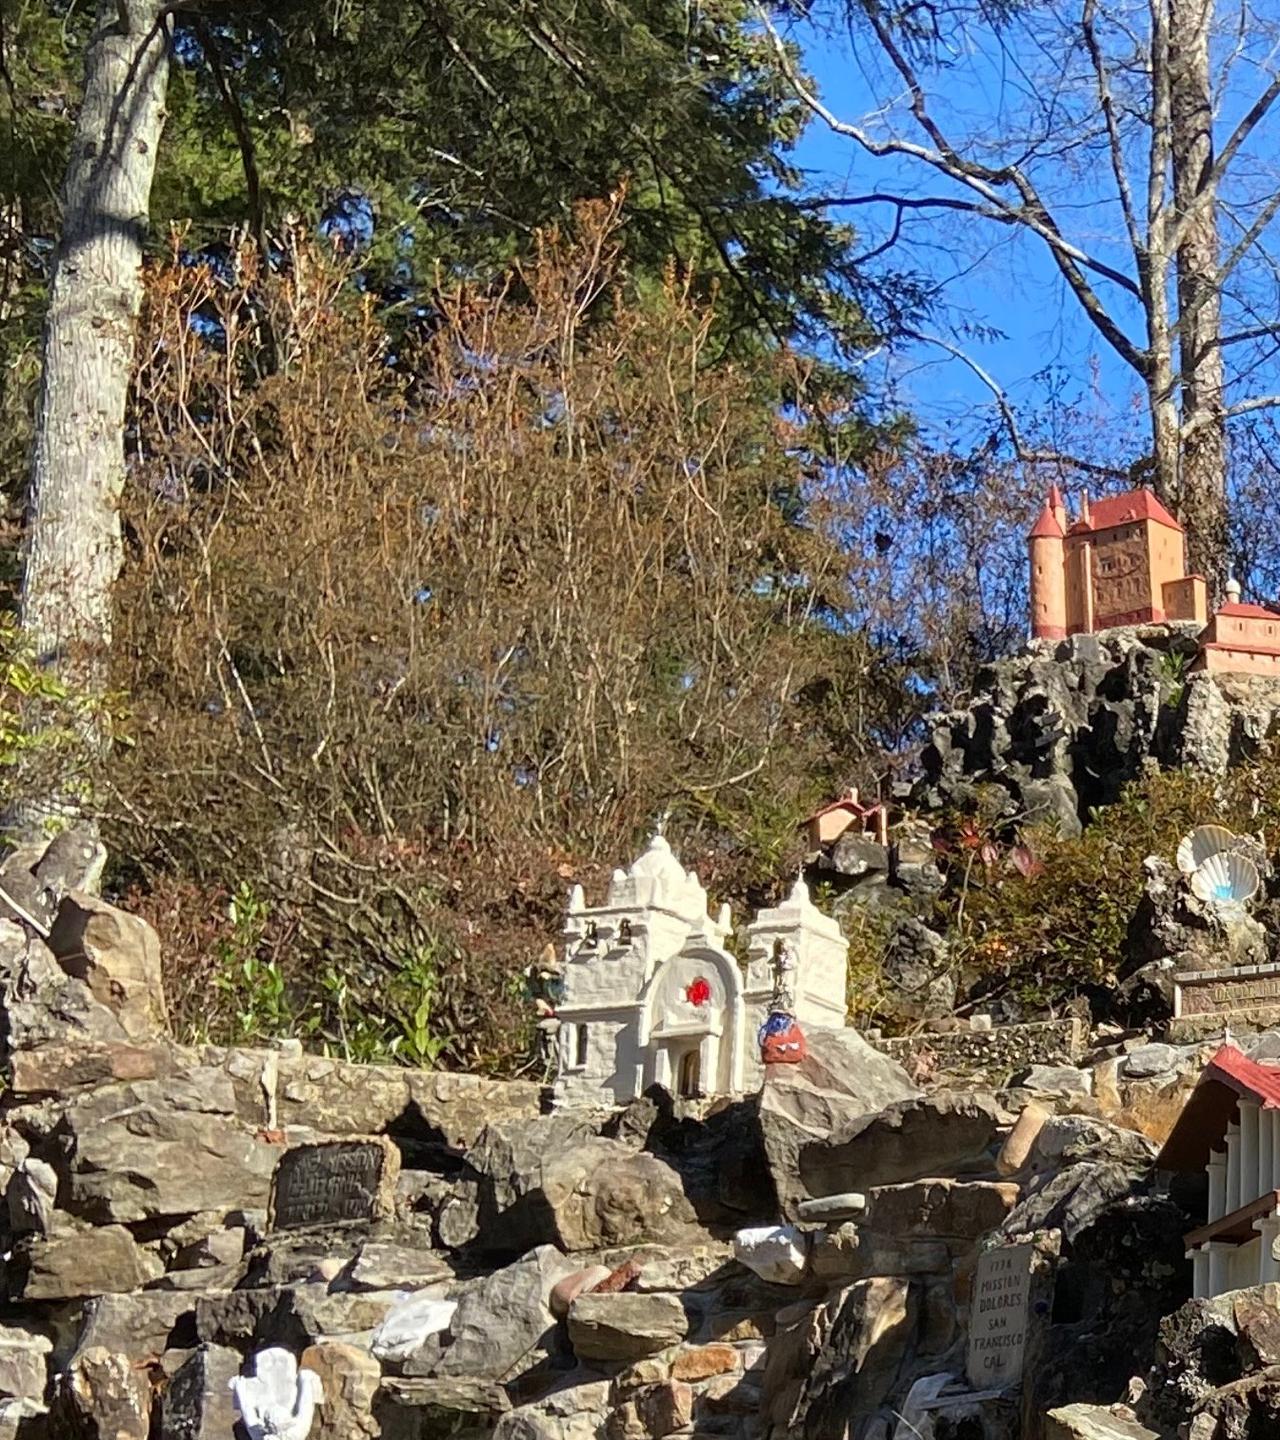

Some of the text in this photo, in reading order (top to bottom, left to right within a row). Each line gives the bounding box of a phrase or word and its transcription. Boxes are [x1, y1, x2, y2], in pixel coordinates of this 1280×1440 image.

[981, 1274, 1021, 1294] MISSION
[979, 1292, 1022, 1312] DOLORES
[988, 1316, 1007, 1331] SAN
[974, 1333, 1024, 1350] FRANCISCO
[983, 1354, 1006, 1369] CAL
